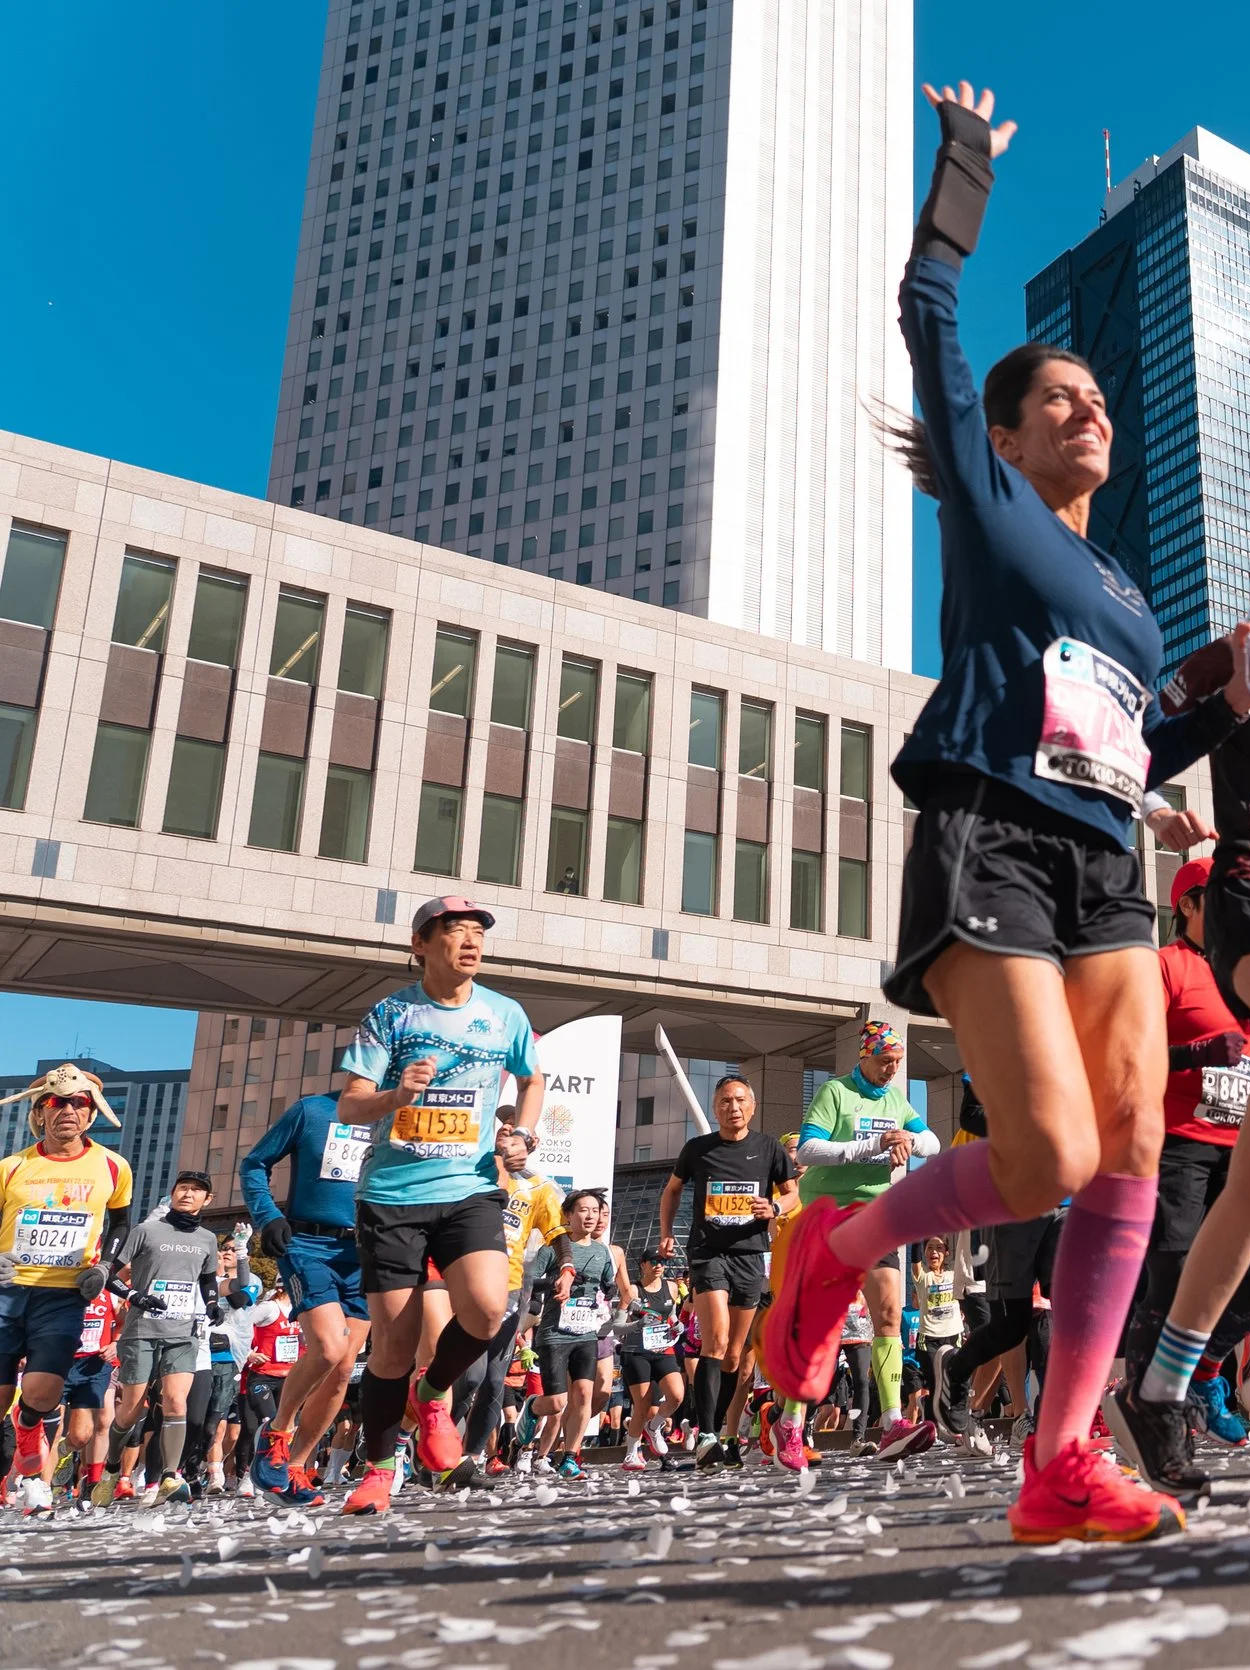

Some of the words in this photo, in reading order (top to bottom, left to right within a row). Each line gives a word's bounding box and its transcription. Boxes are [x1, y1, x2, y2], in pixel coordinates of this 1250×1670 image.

[543, 1073, 596, 1095] TART
[1204, 1073, 1216, 1088] D
[426, 1093, 474, 1104] 東京メトロ
[1206, 1095, 1213, 1105] 3
[398, 1110, 408, 1122] E
[415, 1111, 469, 1135] 11533
[856, 1132, 864, 1141] D
[328, 1142, 337, 1151] D
[541, 1138, 573, 1148] OKYO
[539, 1153, 571, 1164] 2024
[510, 1198, 533, 1214] ers
[41, 1213, 85, 1224] 東京メトロ
[17, 1228, 25, 1238] E
[29, 1228, 77, 1248] 80241
[175, 1244, 203, 1255] ROUTE
